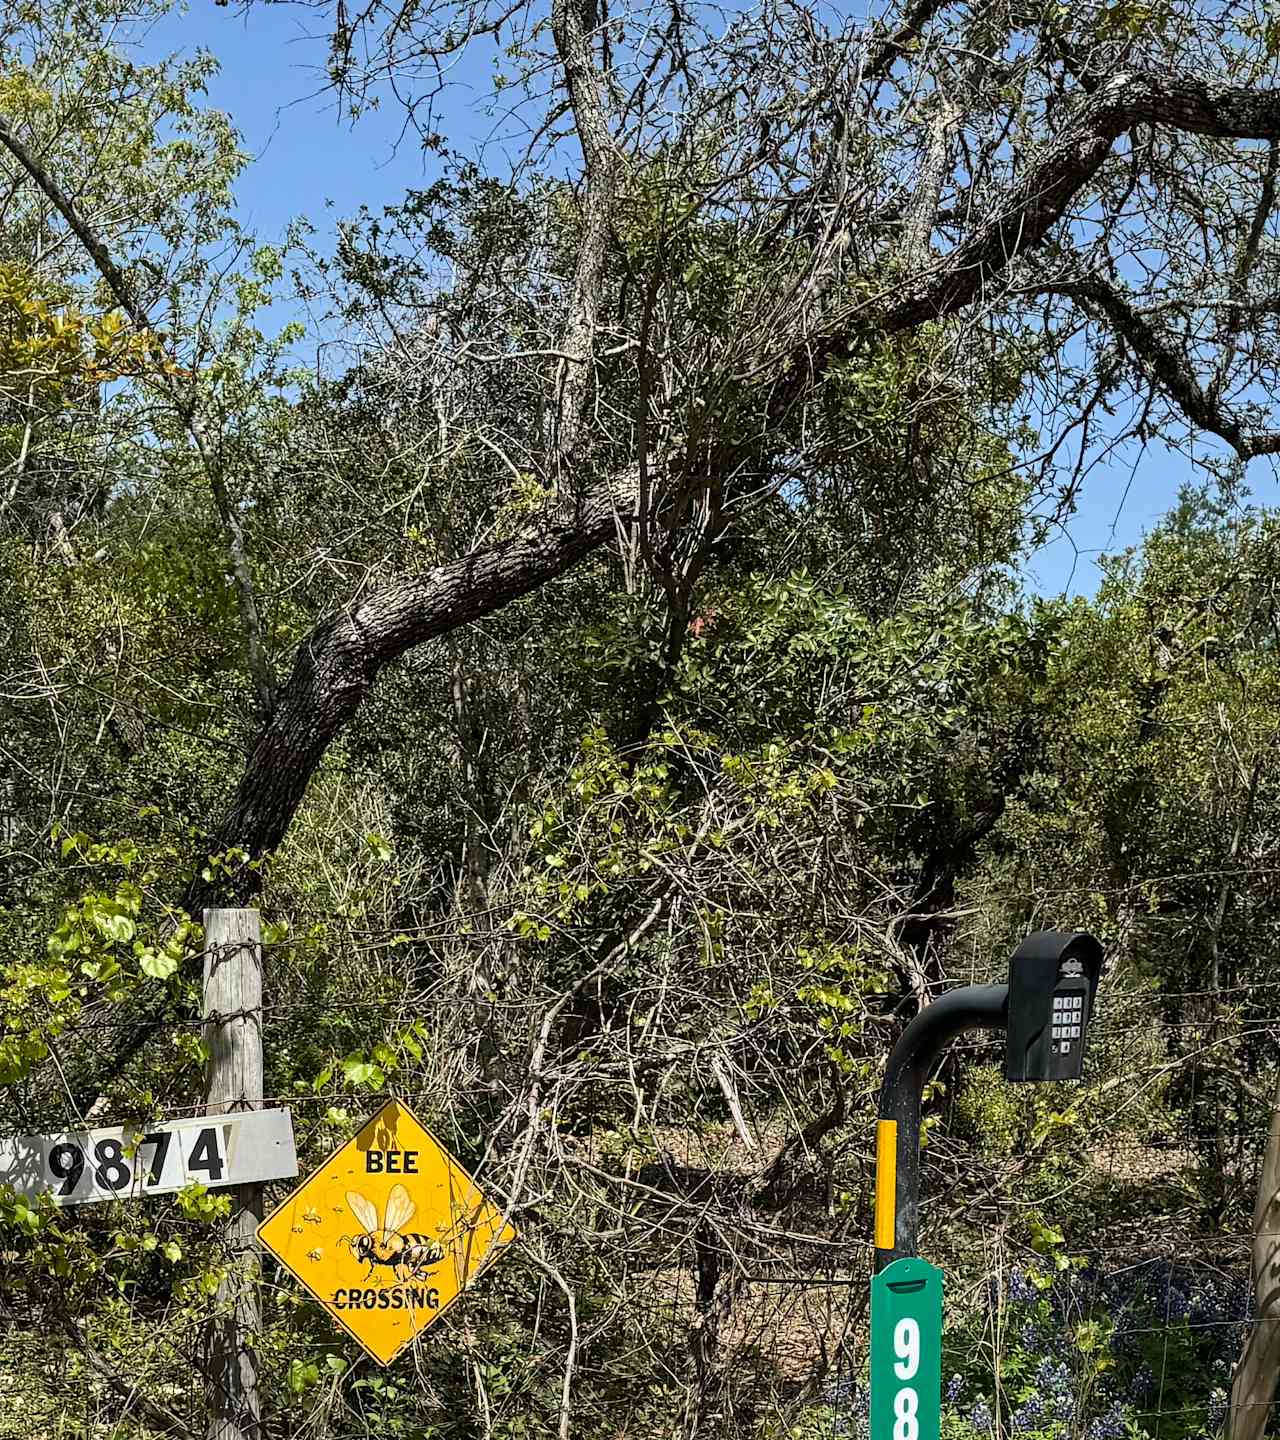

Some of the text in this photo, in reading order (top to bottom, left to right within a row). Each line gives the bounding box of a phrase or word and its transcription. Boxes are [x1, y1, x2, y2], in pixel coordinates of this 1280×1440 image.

[48, 1125, 225, 1197] 9874
[365, 1149, 420, 1175] BEE
[333, 1286, 441, 1312] CROSSING
